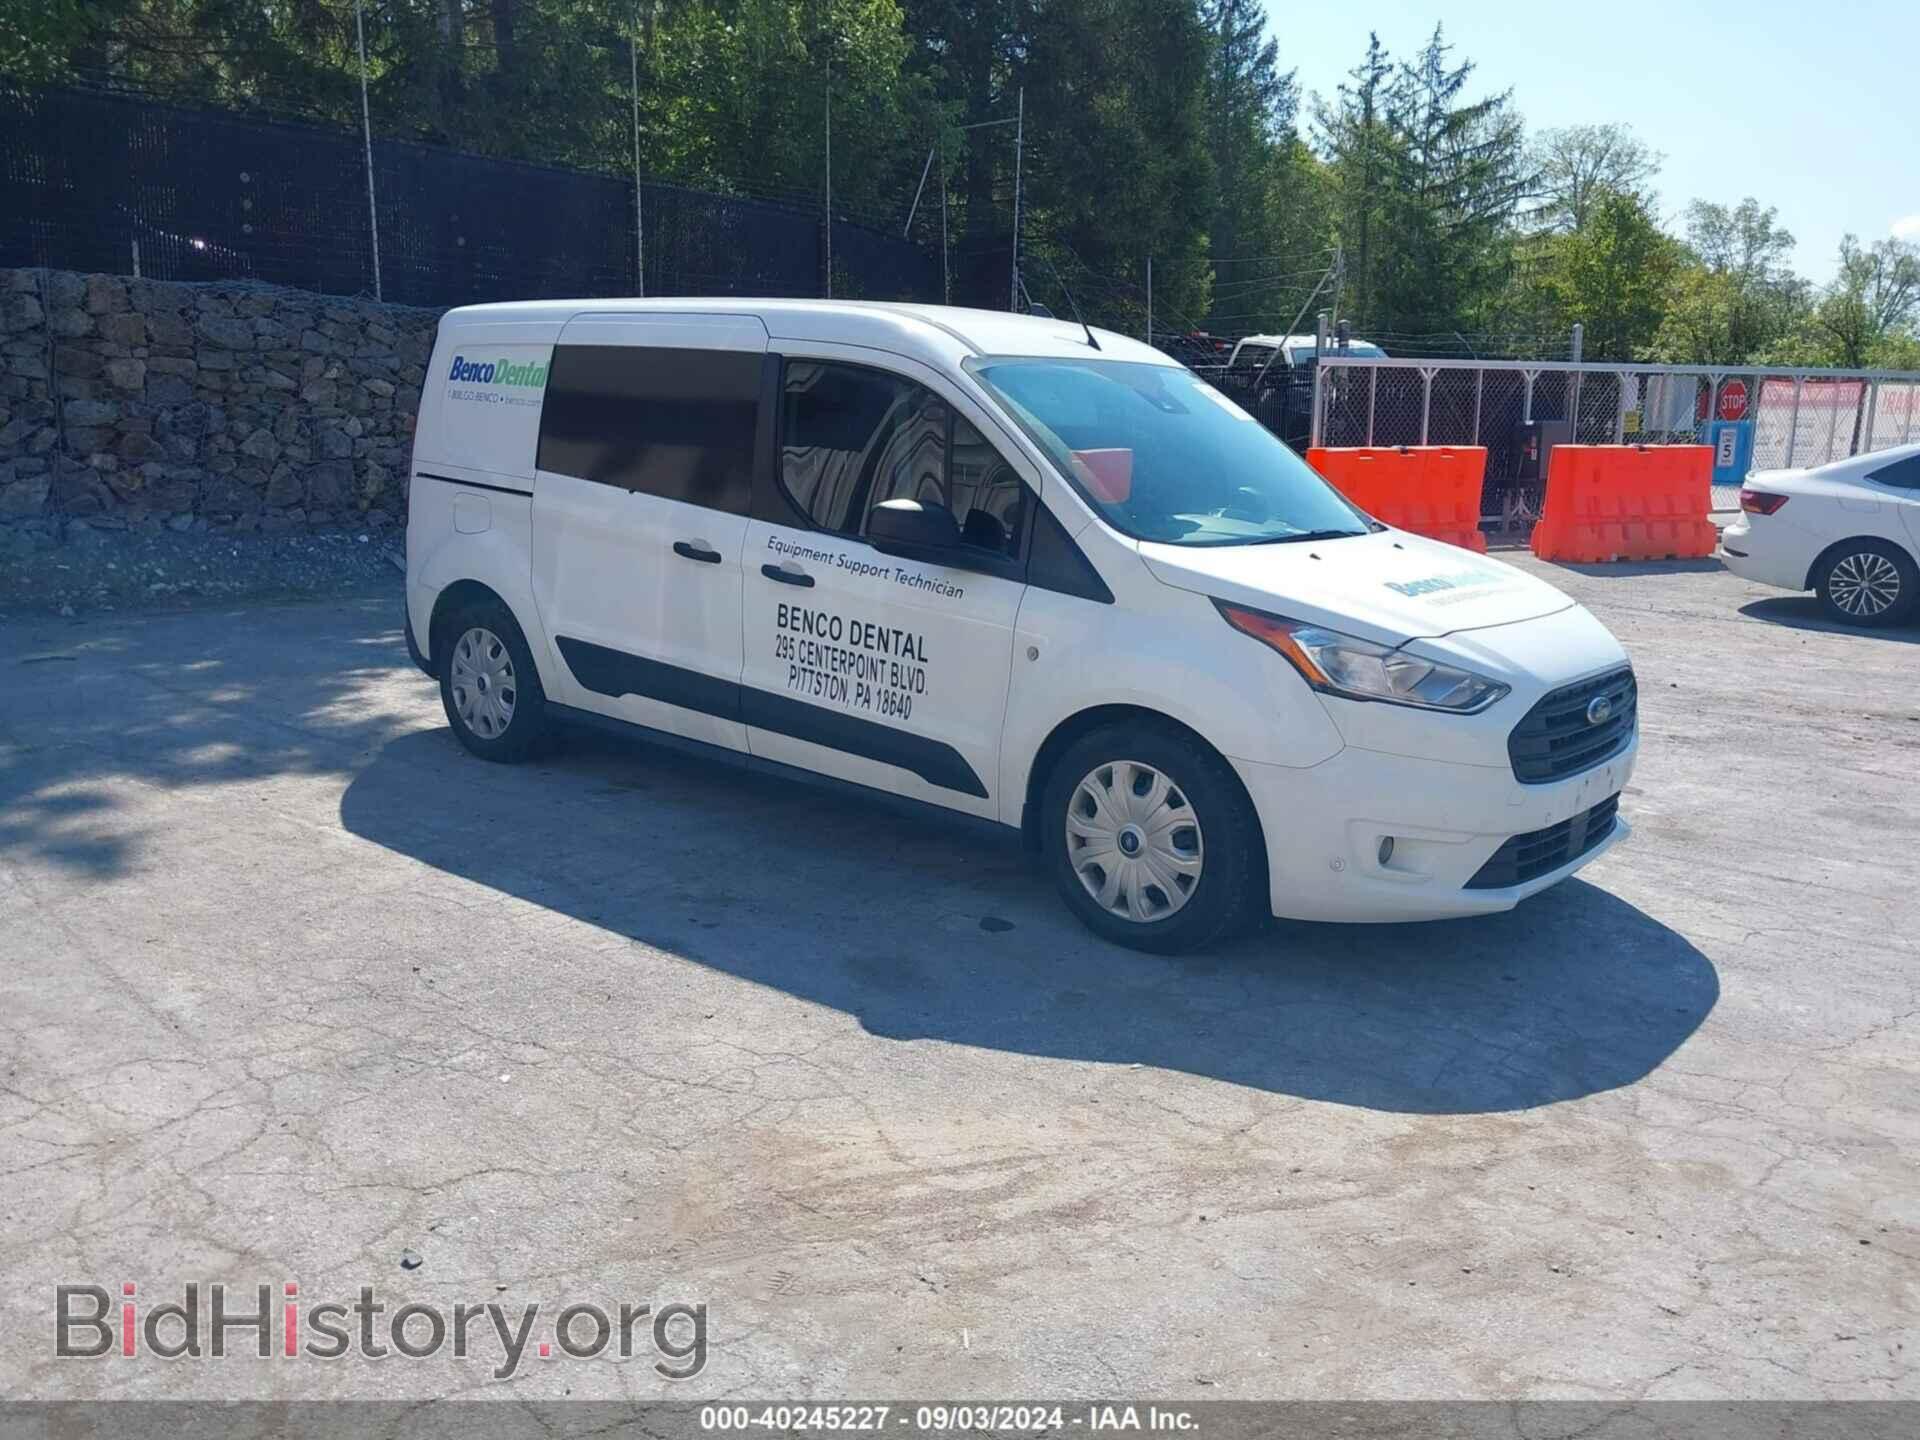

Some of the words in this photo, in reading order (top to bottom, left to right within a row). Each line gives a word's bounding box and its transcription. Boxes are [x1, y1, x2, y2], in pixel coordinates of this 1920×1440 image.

[1721, 394, 1745, 410] STOP
[1723, 444, 1731, 458] 5
[767, 535, 834, 563] Equipment
[836, 554, 890, 579] Support
[895, 568, 964, 599] Technician
[777, 603, 842, 641] BENCO
[850, 620, 928, 663] DENTAL
[775, 634, 795, 660] 295
[799, 640, 886, 684] CENTERPOINT
[891, 662, 929, 695] BLVD.
[788, 665, 850, 706] PITTSTON,
[854, 682, 871, 709] PA
[876, 690, 912, 720] 18640
